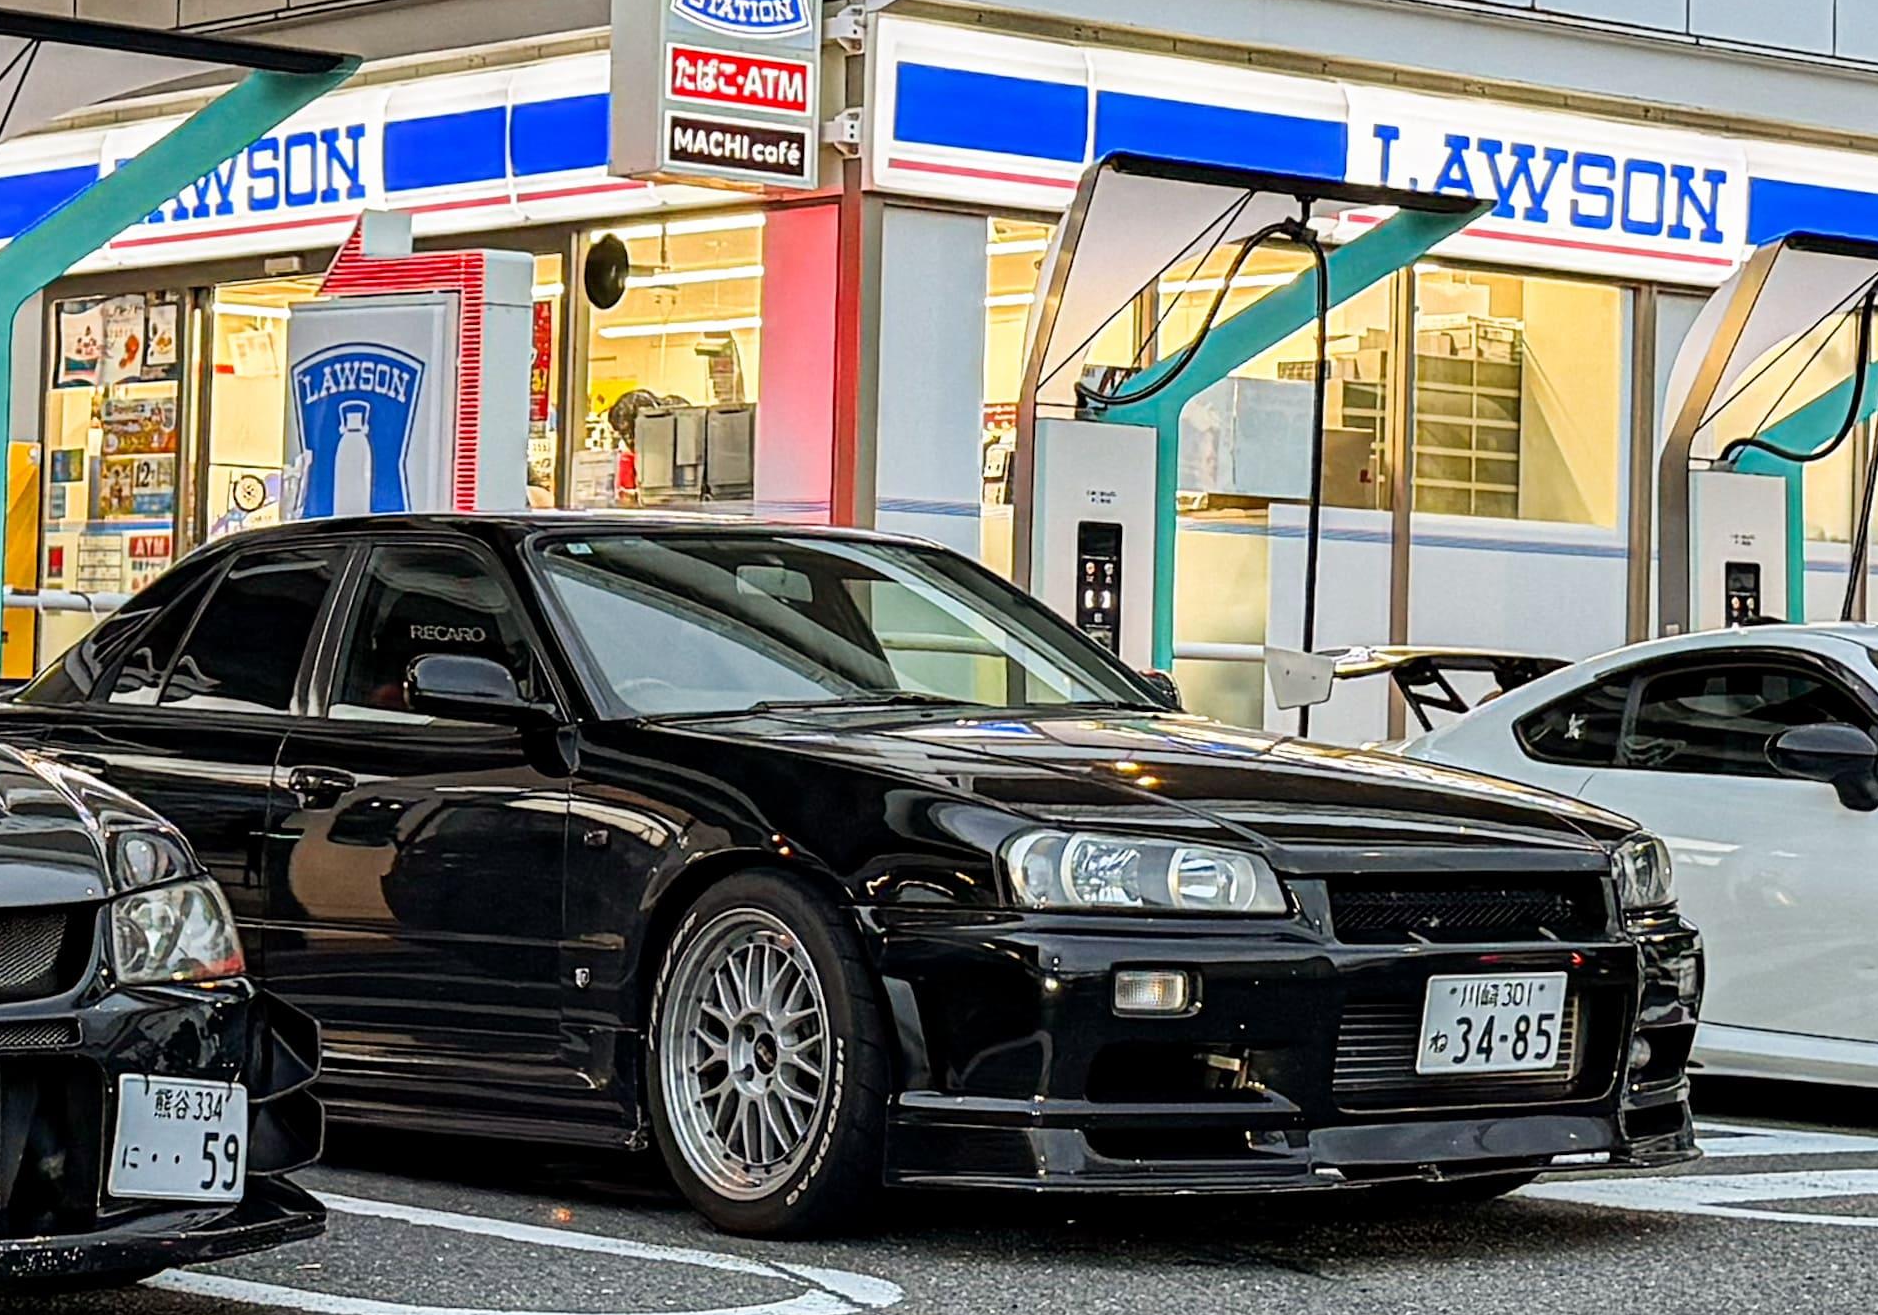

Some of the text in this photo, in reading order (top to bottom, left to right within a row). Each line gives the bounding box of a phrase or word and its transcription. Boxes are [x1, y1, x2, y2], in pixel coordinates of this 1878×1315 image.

[673, 126, 801, 166] MACHI café
[303, 361, 410, 404] LAWSON
[134, 538, 168, 556] ATM
[409, 625, 487, 642] RECARO
[1501, 982, 1533, 1007] 301
[1428, 1013, 1555, 1065] ね 34-85
[154, 1088, 224, 1122] 熊谷 334
[122, 1145, 140, 1170] に
[200, 1132, 239, 1192] 59
